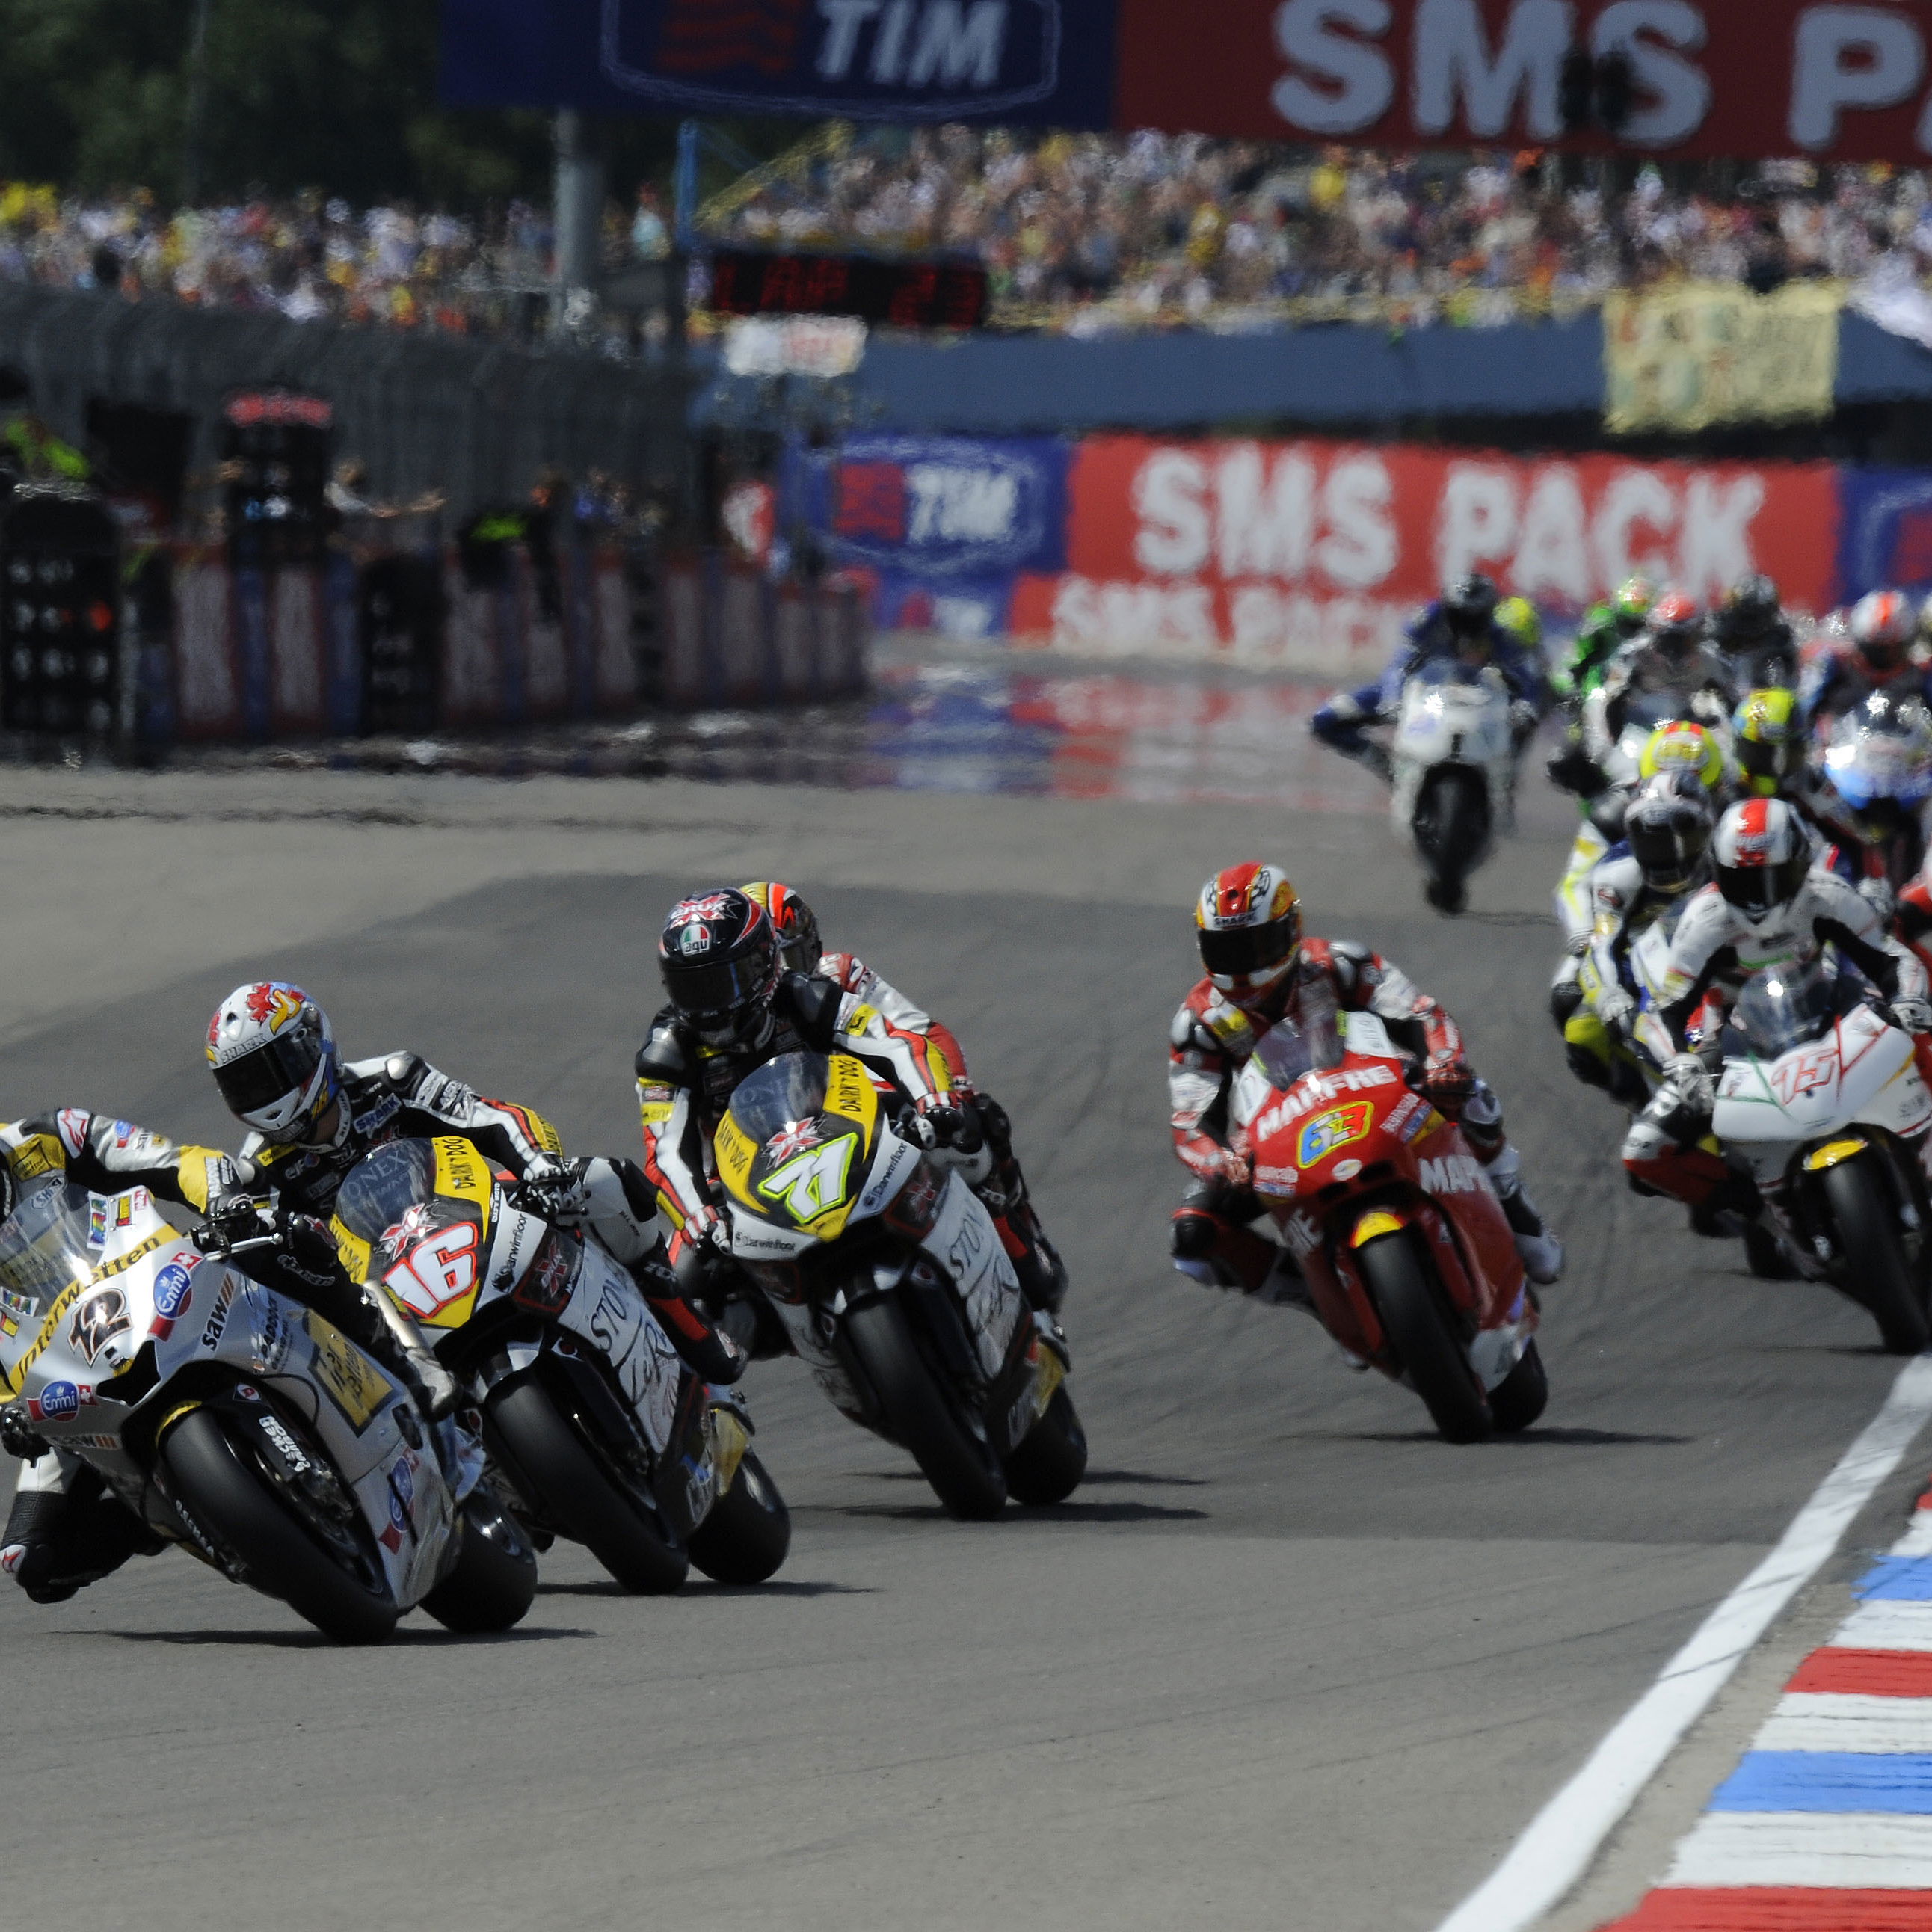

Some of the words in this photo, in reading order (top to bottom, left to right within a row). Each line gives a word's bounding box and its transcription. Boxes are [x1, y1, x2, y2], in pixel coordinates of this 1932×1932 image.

[817, 0, 1009, 86] TIM
[1271, 0, 1710, 144] SMS
[1788, 4, 1932, 156] P
[1132, 441, 1397, 588] SMS
[1439, 459, 1765, 602] PACK
[221, 1035, 266, 1062] SHARK
[443, 1138, 468, 1157] DOG
[1298, 1101, 1375, 1169] 63
[450, 1160, 476, 1190] DARK
[156, 1267, 188, 1313] Emmi
[382, 1222, 479, 1318] 16
[67, 1288, 132, 1368] 12
[43, 1392, 76, 1411] Emmi
